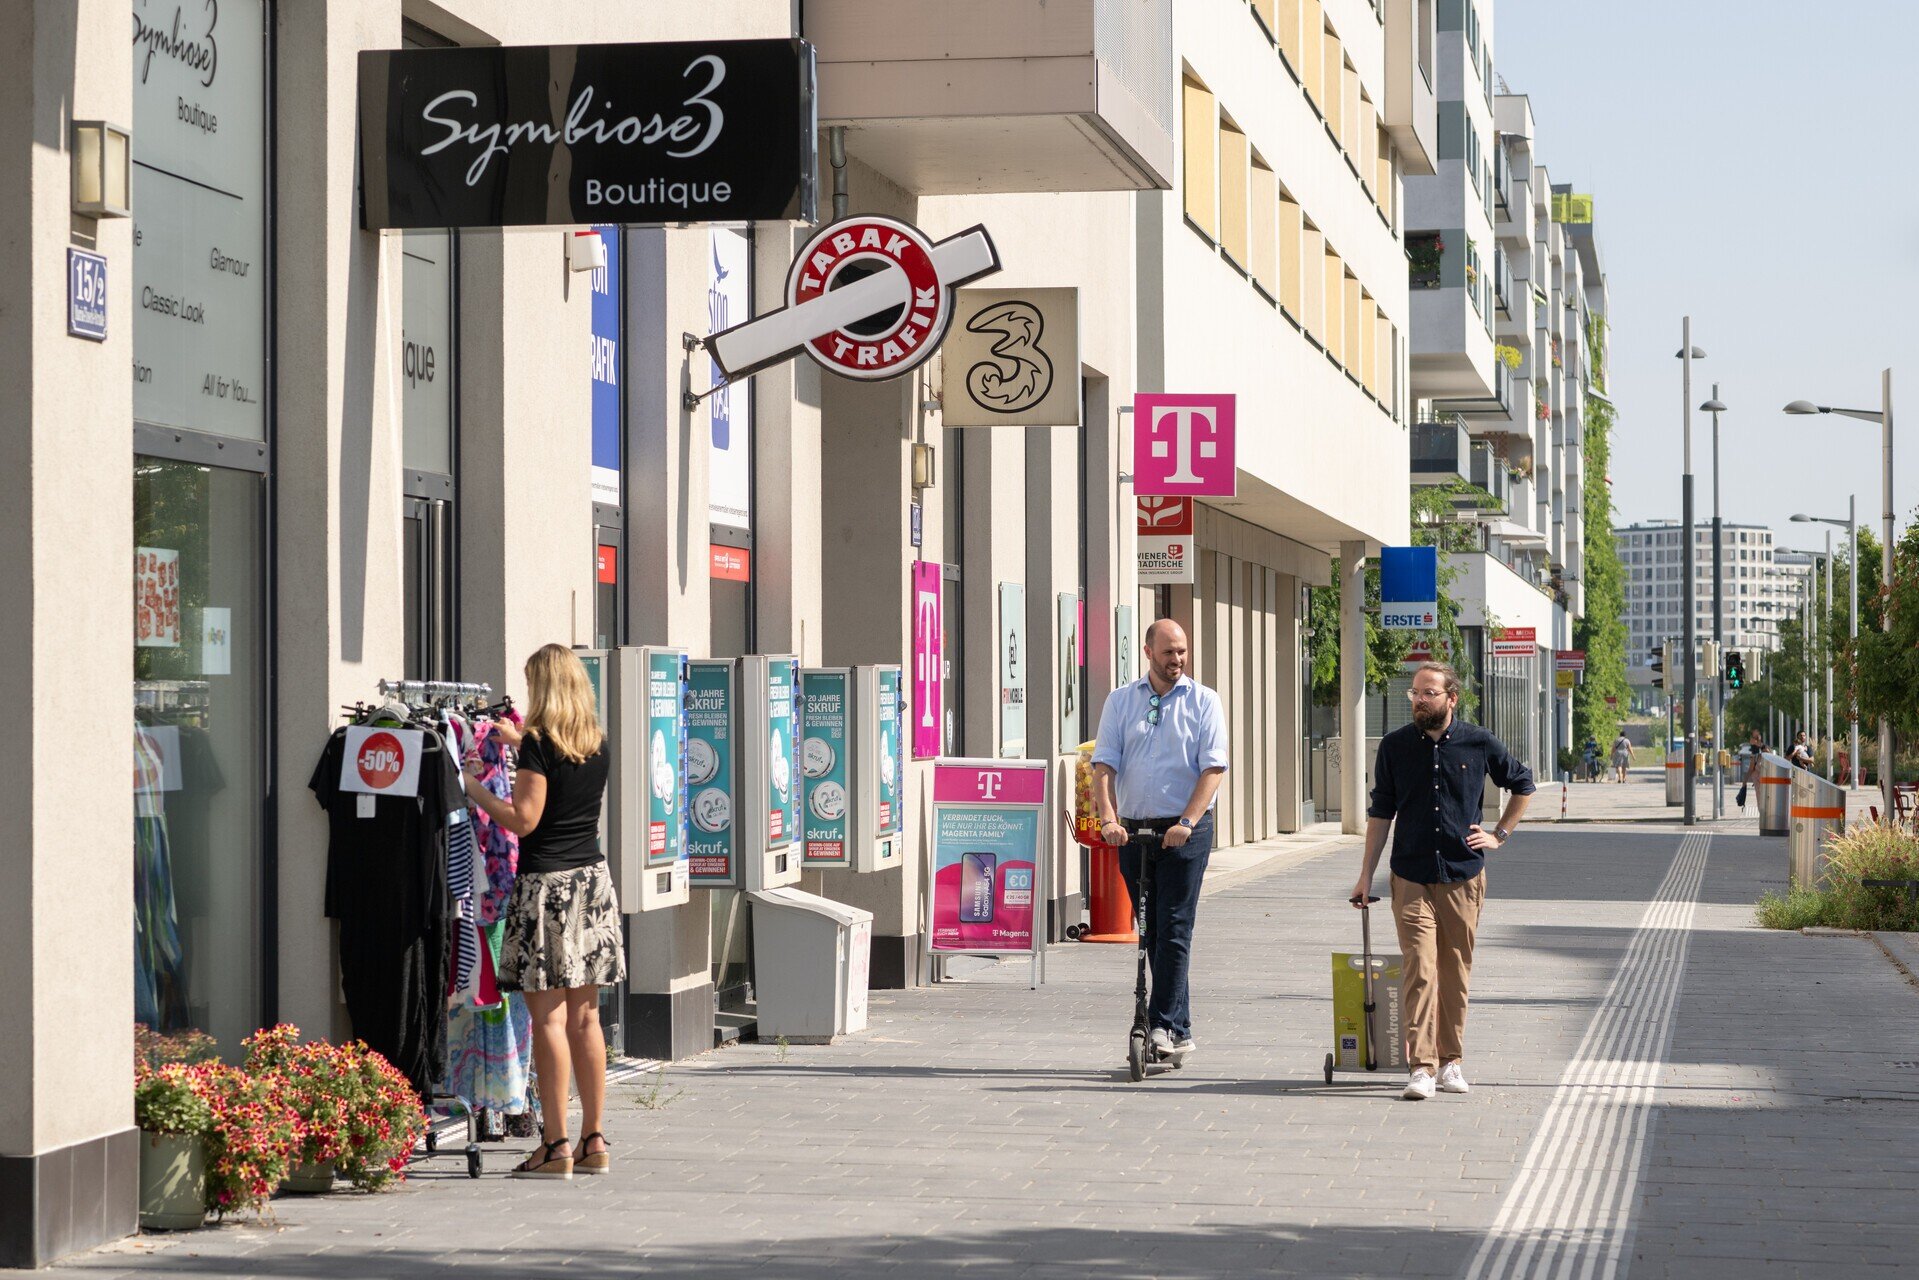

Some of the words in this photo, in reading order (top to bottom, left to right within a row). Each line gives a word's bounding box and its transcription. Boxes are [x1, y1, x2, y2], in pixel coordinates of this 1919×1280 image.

[178, 96, 217, 135] Boutique
[586, 178, 732, 209] Boutique
[211, 247, 250, 278] Glamour
[801, 228, 911, 291] TABAK
[76, 259, 104, 307] 15/2
[142, 286, 179, 317] Classic
[181, 297, 205, 325] Look
[833, 285, 936, 365] TRAFIK
[591, 333, 616, 386] RAFIK
[967, 301, 1054, 414] 3
[203, 373, 216, 396] All
[217, 376, 229, 398] for
[1152, 406, 1217, 484] T
[1138, 560, 1183, 568] TÄDTISCHE
[1384, 614, 1422, 626] ERSTE
[699, 690, 725, 698] JAHRE
[808, 703, 841, 713] SKRUF
[692, 719, 727, 727] GEWINNEN
[359, 750, 400, 773] -50%
[978, 772, 1002, 799] T
[807, 828, 843, 840] skruf.
[997, 822, 1024, 831] KÖNNT.
[688, 841, 728, 854] skruf.
[983, 866, 991, 877] 5G
[1009, 874, 1028, 887] €0
[974, 881, 982, 917] SAMSUNG
[982, 890, 991, 917] Galaxy
[1000, 930, 1029, 938] Magenta
[1386, 986, 1400, 1066] www.krone.at
